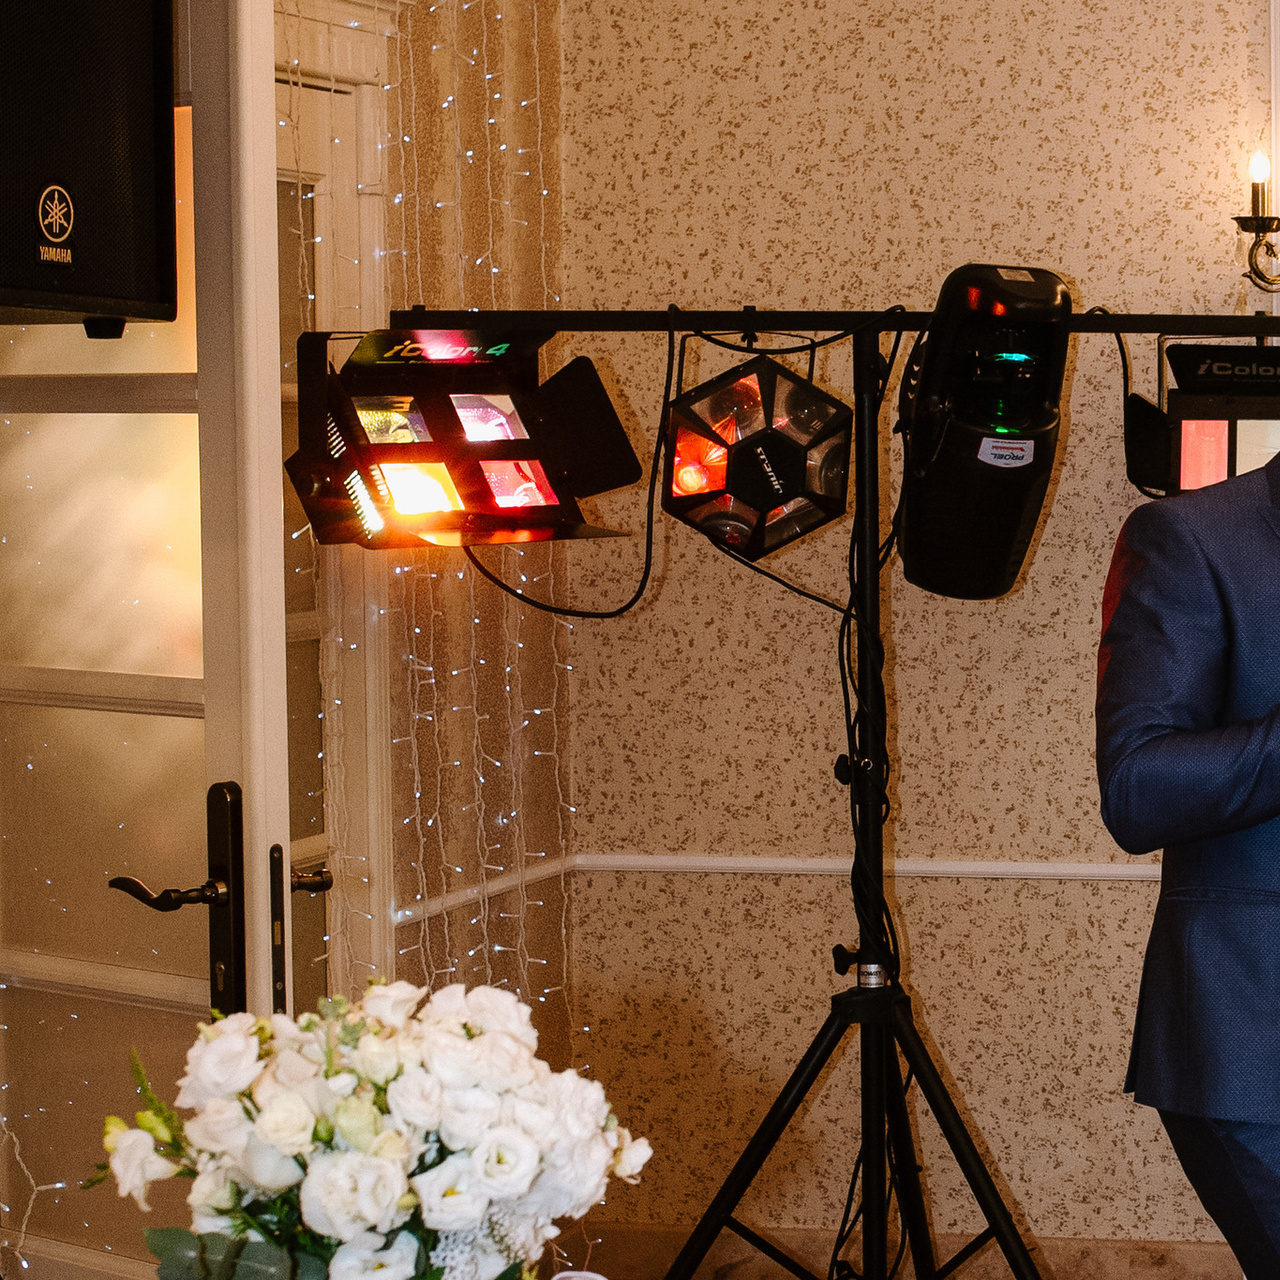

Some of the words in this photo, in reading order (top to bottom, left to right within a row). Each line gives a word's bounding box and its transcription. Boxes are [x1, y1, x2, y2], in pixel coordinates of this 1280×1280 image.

[39, 245, 72, 264] YAMAHA
[486, 343, 510, 357] 4
[990, 452, 1025, 461] PROEL
